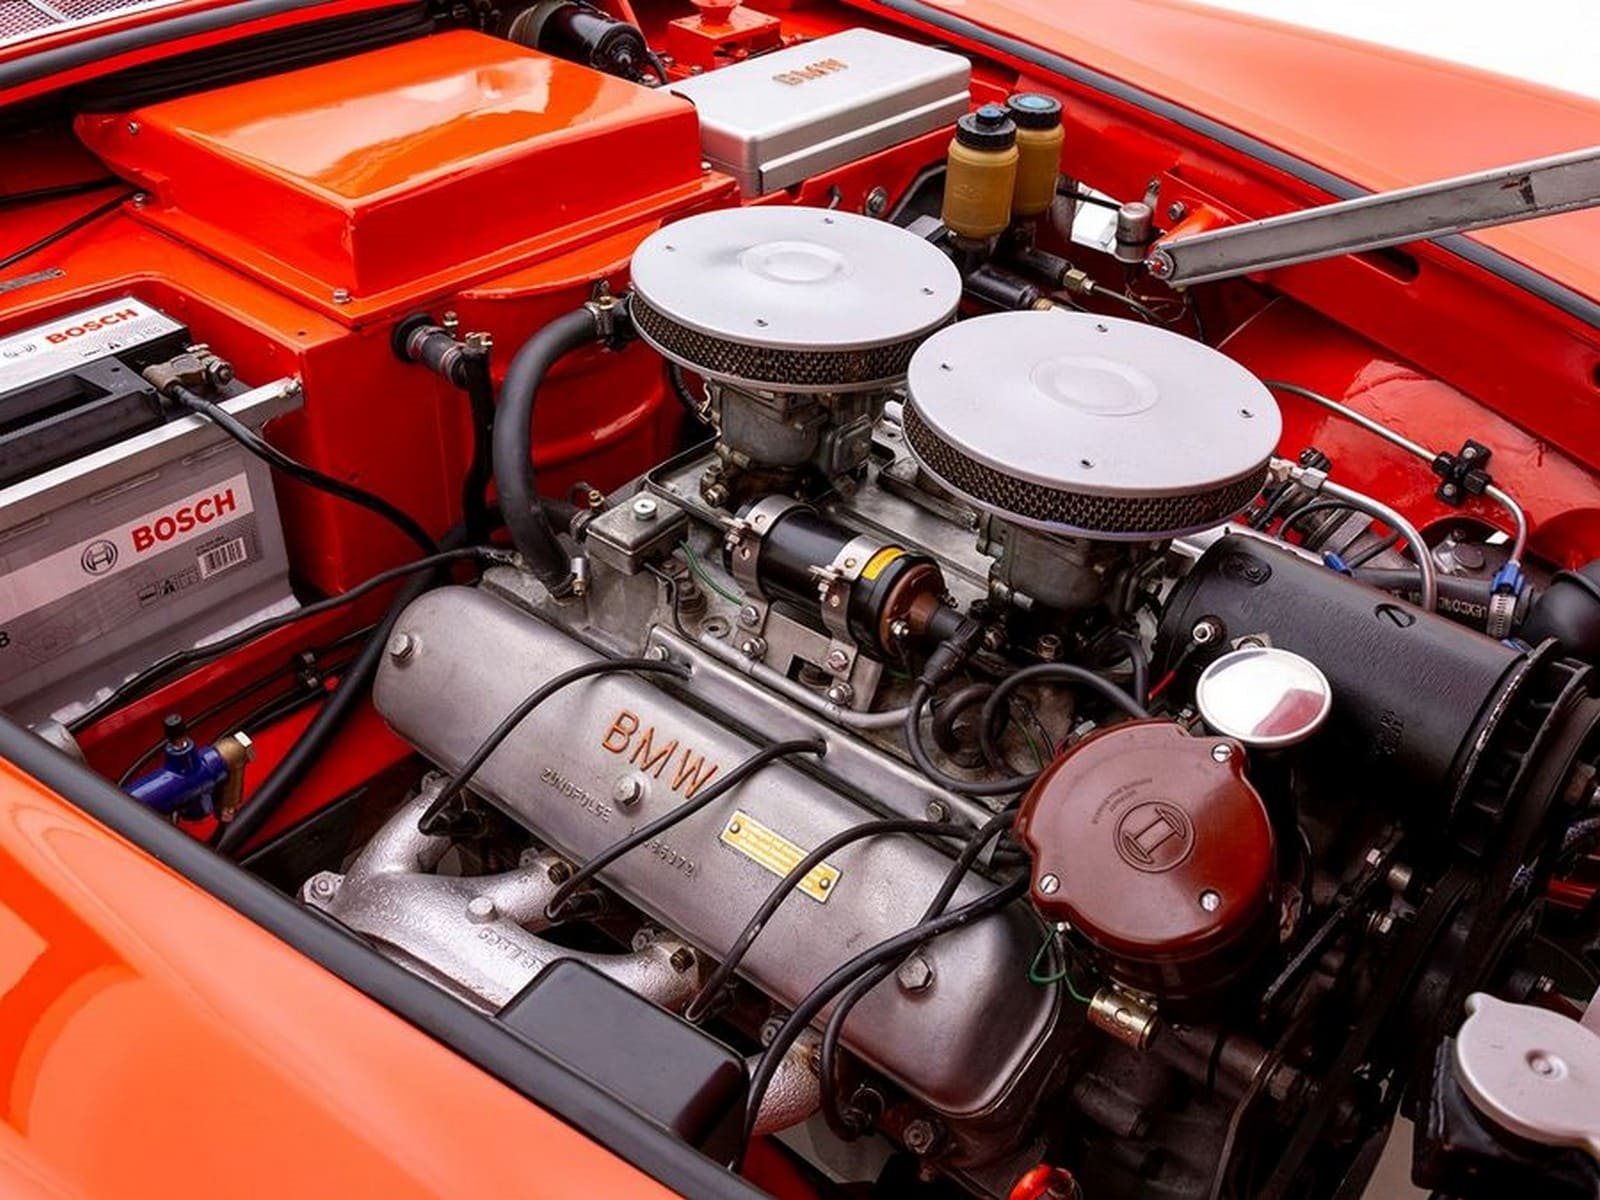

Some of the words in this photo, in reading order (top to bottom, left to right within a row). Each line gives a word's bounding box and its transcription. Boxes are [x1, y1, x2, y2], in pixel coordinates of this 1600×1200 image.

[771, 58, 848, 86] BMW
[45, 308, 139, 345] BOSCH
[131, 488, 237, 553] BOSCH
[602, 708, 719, 800] BMW
